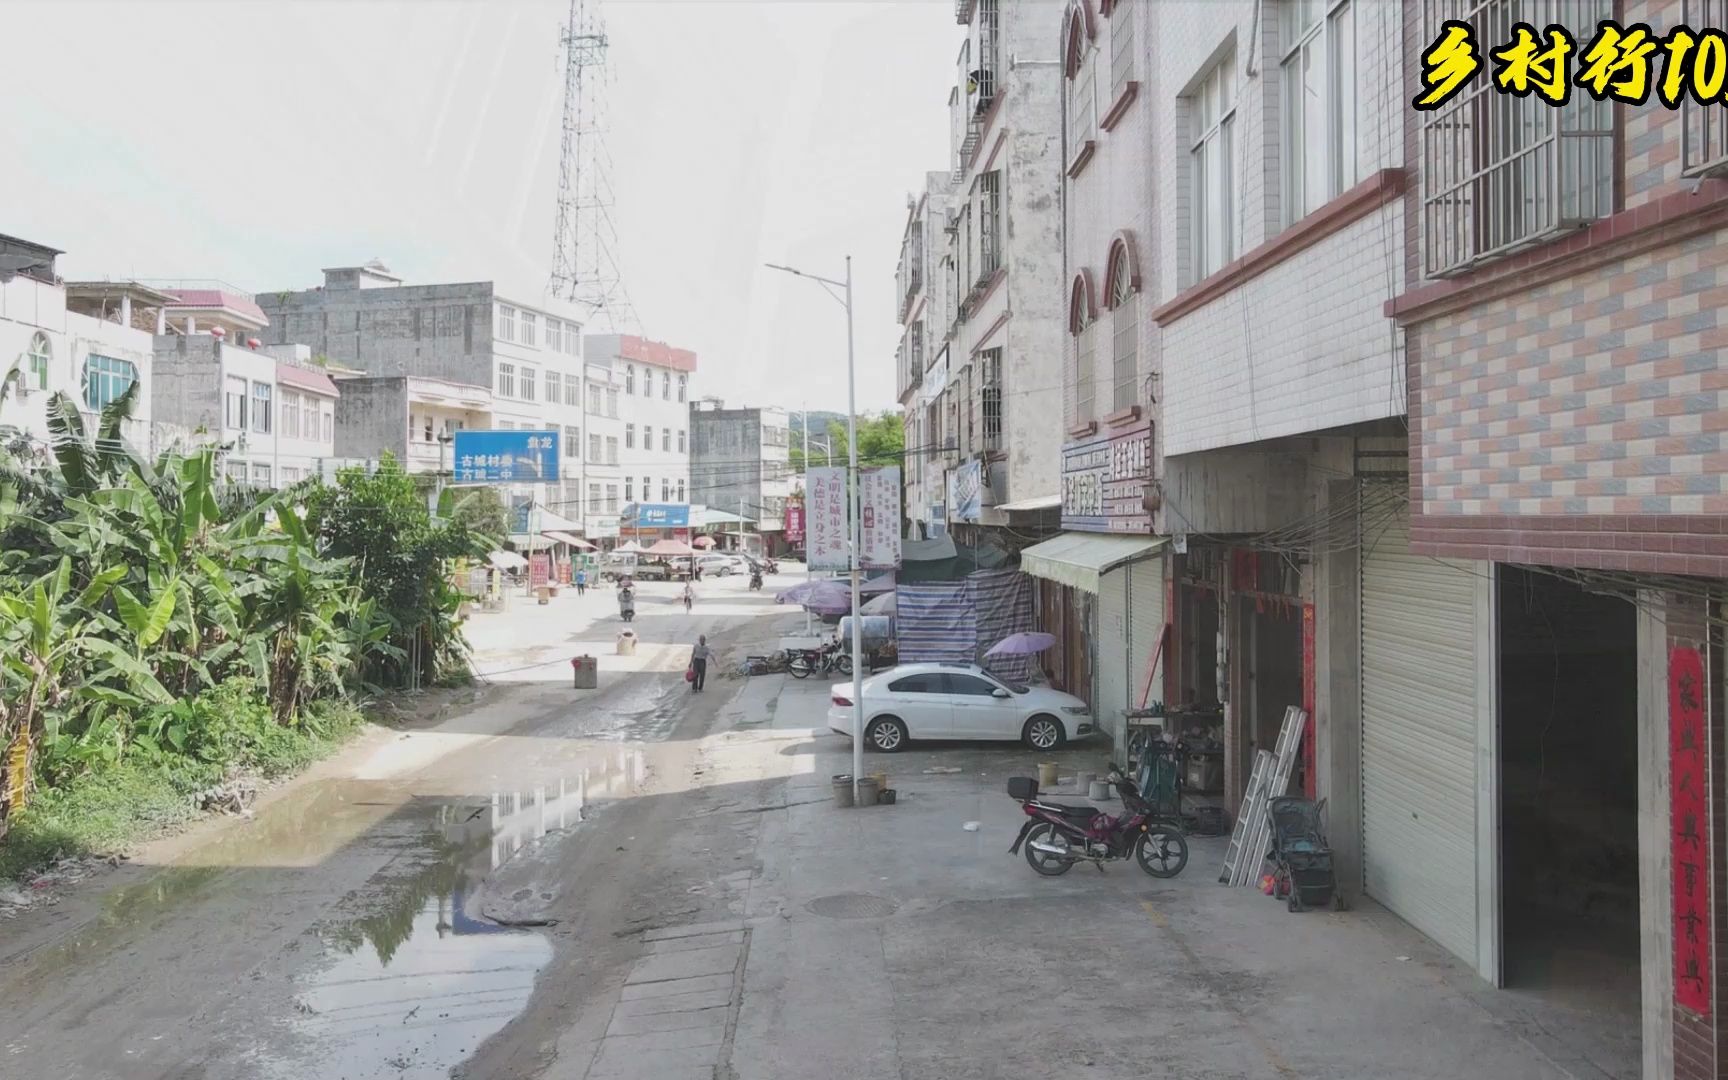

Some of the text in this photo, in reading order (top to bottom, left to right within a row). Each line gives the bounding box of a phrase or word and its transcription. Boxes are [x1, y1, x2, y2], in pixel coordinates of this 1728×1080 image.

[814, 476, 826, 556] 美德是立身之本
[829, 471, 842, 551] 文明是城市之魂
